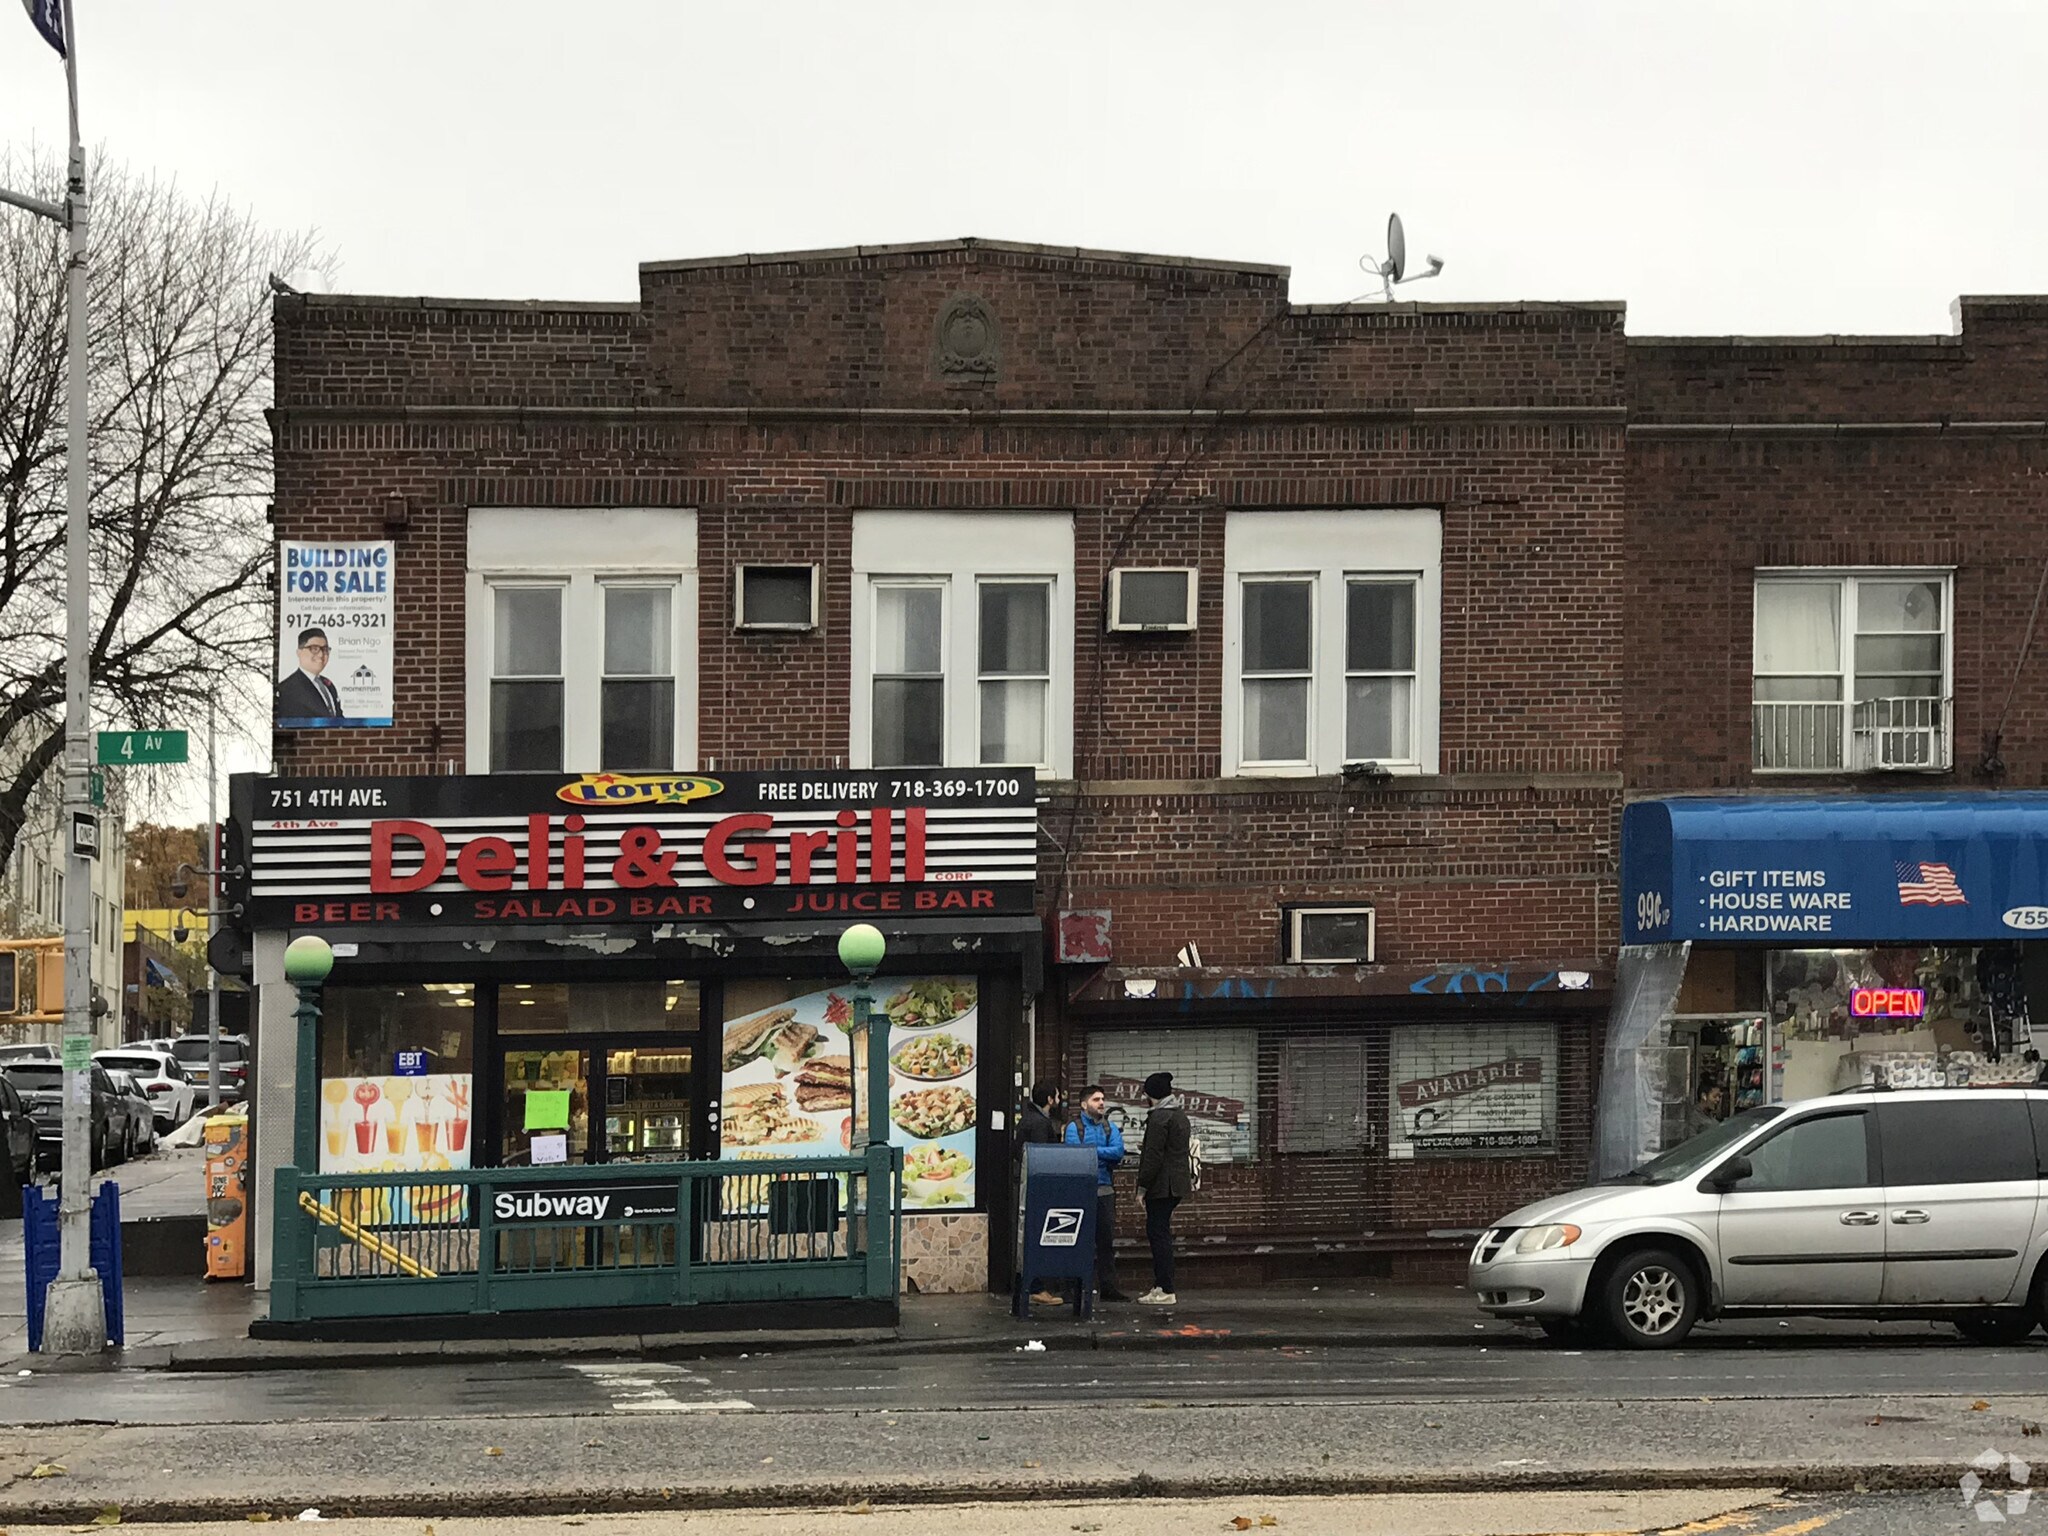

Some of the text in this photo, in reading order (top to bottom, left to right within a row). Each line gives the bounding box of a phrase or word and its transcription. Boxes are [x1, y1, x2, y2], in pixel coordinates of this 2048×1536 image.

[287, 547, 388, 568] BUILDING
[287, 570, 387, 594] FOR SALE
[351, 596, 388, 604] property?
[287, 613, 387, 628] 917-463-9321
[338, 637, 382, 648] Brian Ngo
[121, 735, 134, 759] 4
[271, 788, 387, 807] 751 4TH AVE.
[580, 781, 696, 801] LOTTO
[758, 779, 1020, 801] FREE DELIVERY 718-369-1700
[271, 819, 339, 829] 4th Ave
[370, 807, 927, 893] Deli & Grill
[934, 871, 974, 882] CORP
[1709, 870, 1827, 887] GIFT ITEMS
[294, 889, 996, 924] BEER SALAD BAR JUICE BAR
[1709, 892, 1852, 909] HOUSE WARE
[1709, 914, 1833, 931] HARDWARE
[2011, 911, 2048, 926] 755
[1853, 989, 1923, 1016] OPEN
[398, 1052, 423, 1066] EBT
[1416, 1062, 1525, 1100] AVAILABLE
[1114, 1081, 1227, 1117] AVABLE
[494, 1193, 611, 1220] Subway
